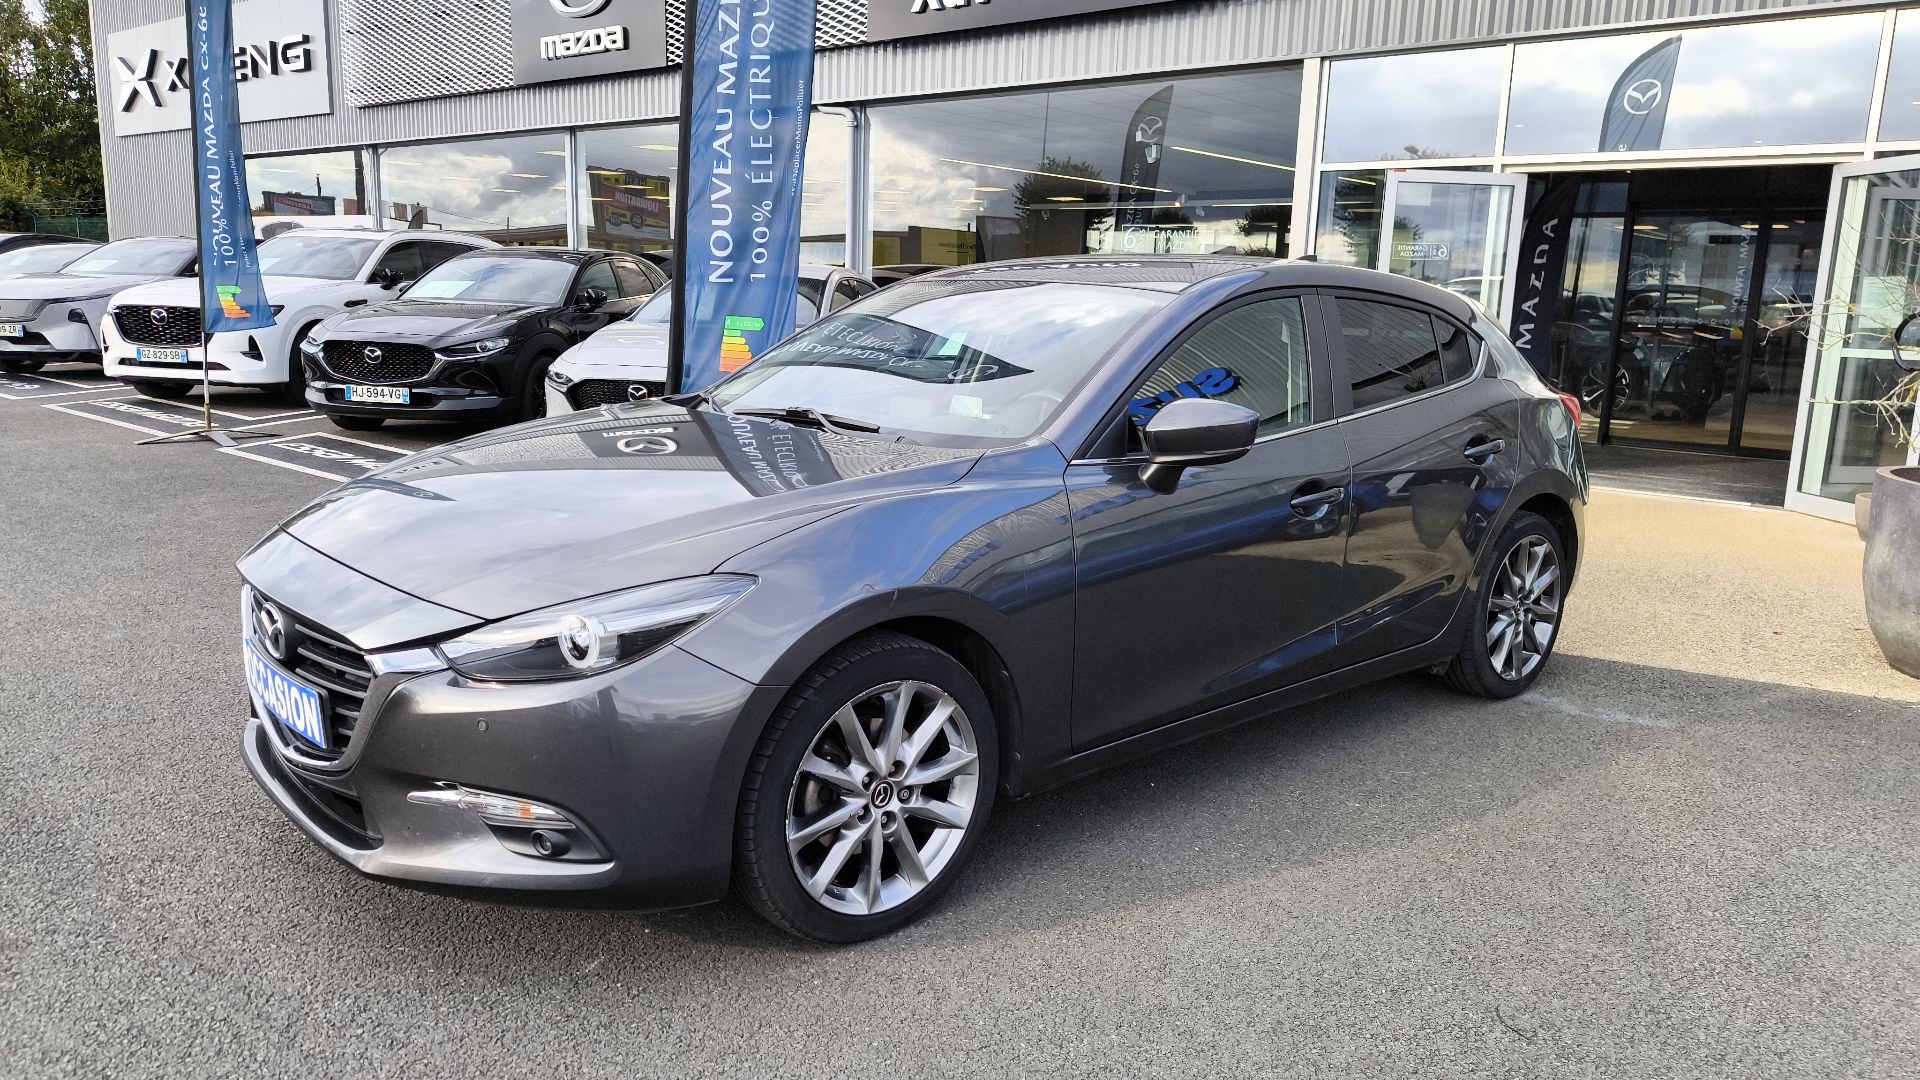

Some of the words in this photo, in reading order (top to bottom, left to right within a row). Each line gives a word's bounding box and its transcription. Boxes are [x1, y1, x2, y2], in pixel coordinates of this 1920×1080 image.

[201, 77, 219, 159] MAZDA
[708, 108, 734, 283] NOUVEAU
[219, 218, 238, 267] 100%
[750, 200, 773, 283] 100%
[1123, 226, 1136, 249] 6
[1153, 229, 1200, 239] GARANTIE
[1157, 240, 1193, 250] MAZDA
[1515, 217, 1559, 349] MAZDA
[141, 350, 181, 360] GZ-829-SB
[351, 385, 402, 399] HJ-594-VG
[247, 645, 322, 743] OCCASION
